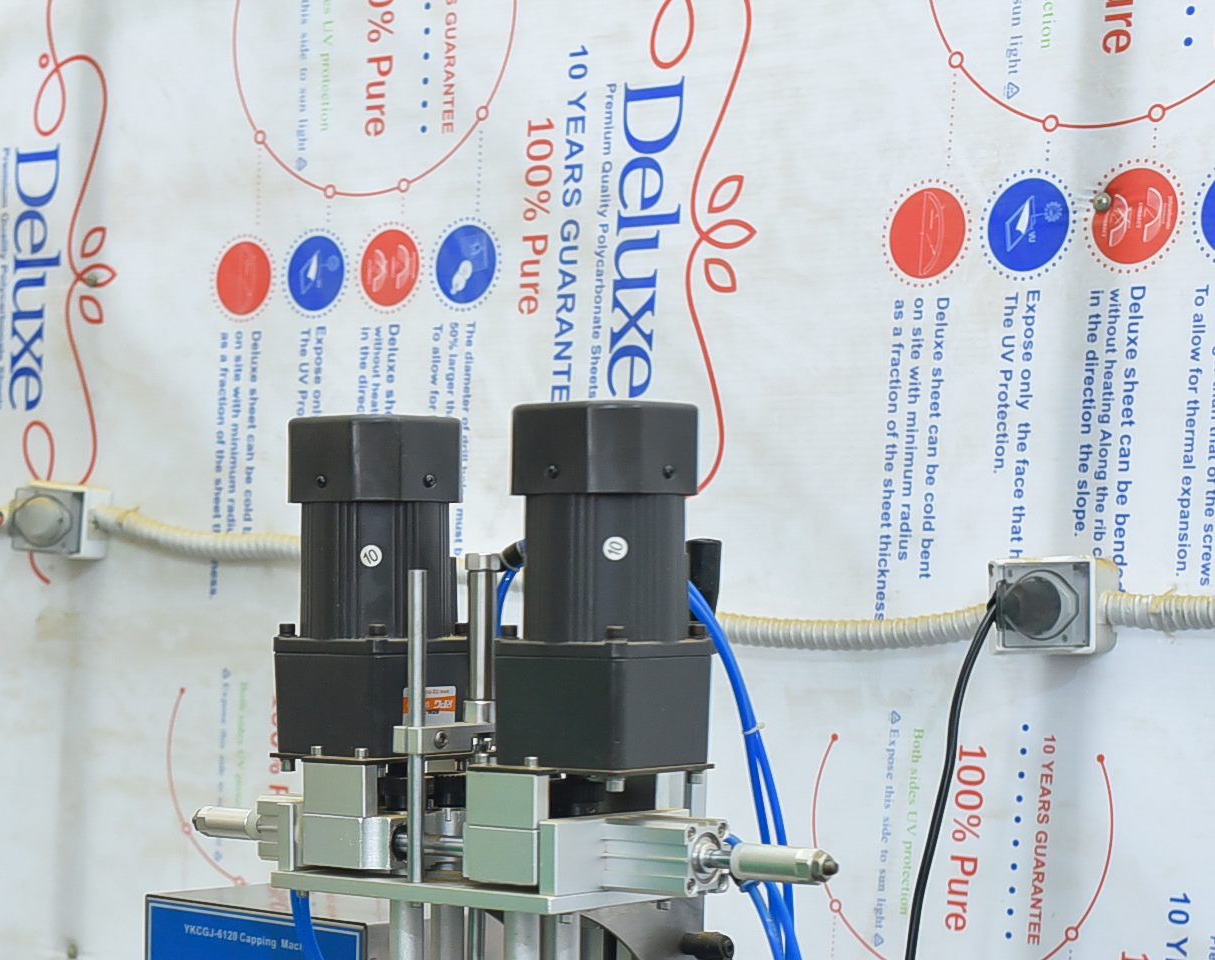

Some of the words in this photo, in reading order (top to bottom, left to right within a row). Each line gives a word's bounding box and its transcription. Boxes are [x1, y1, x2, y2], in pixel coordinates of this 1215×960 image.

[1040, 0, 1056, 49] ction
[442, 12, 457, 133] GUARANTEE
[568, 45, 588, 79] 10
[365, 56, 393, 136] Pure
[603, 83, 617, 155] Premium
[524, 118, 554, 221] 100%
[562, 92, 586, 207] YEARS
[597, 161, 612, 217] Quality
[607, 76, 685, 398] Deluxe
[9, 144, 61, 411] Deluxe
[518, 234, 548, 314] Pure
[592, 224, 609, 339] Polycarbonate
[549, 220, 580, 404] GUARANTE
[894, 300, 904, 320] as
[913, 298, 924, 320] on
[1003, 294, 1018, 328] The
[1090, 290, 1104, 306] in
[1194, 285, 1209, 306] To
[893, 327, 902, 336] a
[933, 298, 950, 360] Deluxe
[1022, 290, 1040, 362] Expose
[1087, 314, 1102, 343] the
[1105, 288, 1121, 354] without
[1126, 286, 1146, 359] Deluxe
[1190, 314, 1206, 361] allow
[250, 331, 262, 382] Deluxe
[300, 328, 311, 356] The
[911, 328, 924, 360] site
[1001, 336, 1015, 362] UV
[298, 362, 309, 384] UV
[586, 345, 602, 402] Sheets
[888, 343, 904, 413] fraction
[908, 366, 921, 404] with
[930, 368, 944, 418] sheet
[1017, 369, 1033, 410] only
[1081, 350, 1099, 434] direction
[1098, 360, 1117, 424] heating
[1188, 368, 1202, 394] for
[248, 388, 258, 429] sheet
[1121, 368, 1139, 426] sheet
[886, 420, 899, 438] of
[927, 425, 938, 457] can
[994, 370, 1013, 473] Protection.
[1017, 422, 1031, 452] the
[1183, 400, 1200, 469] thermal
[246, 434, 254, 461] can
[884, 444, 898, 472] the
[902, 412, 918, 496] minimum
[1078, 444, 1093, 473] the
[1095, 430, 1112, 480] Along
[1118, 434, 1131, 472] can
[245, 466, 255, 484] be
[926, 464, 939, 486] be
[1014, 459, 1029, 498] face
[1116, 481, 1132, 505] be
[244, 490, 253, 522] cold
[880, 479, 895, 528] sheet
[923, 492, 936, 531] cold
[1073, 480, 1090, 536] slope.
[1095, 486, 1108, 512] the
[898, 504, 912, 560] radius
[1010, 506, 1026, 542] that
[1094, 519, 1106, 541] rib
[1176, 476, 1192, 576] expansion.
[363, 548, 378, 564] 10
[919, 538, 934, 578] bent
[1199, 523, 1214, 587] screws
[875, 534, 892, 621] thickness
[886, 729, 899, 780] Expose
[912, 729, 924, 763] Both
[1043, 735, 1056, 754] 10
[884, 786, 894, 809] this
[908, 768, 920, 805] sides
[952, 745, 986, 842] 100%
[1037, 761, 1054, 824] YEARS
[881, 817, 892, 843] side
[906, 811, 918, 836] UV
[880, 850, 888, 862] to
[878, 868, 886, 892] sun
[900, 840, 912, 915] protection
[945, 855, 978, 931] Pure
[1028, 830, 1048, 945] GUARANTEE
[874, 898, 886, 928] light
[1168, 893, 1190, 924] 10
[184, 924, 238, 941] YKCGJ-6120
[240, 933, 276, 950] Capping
